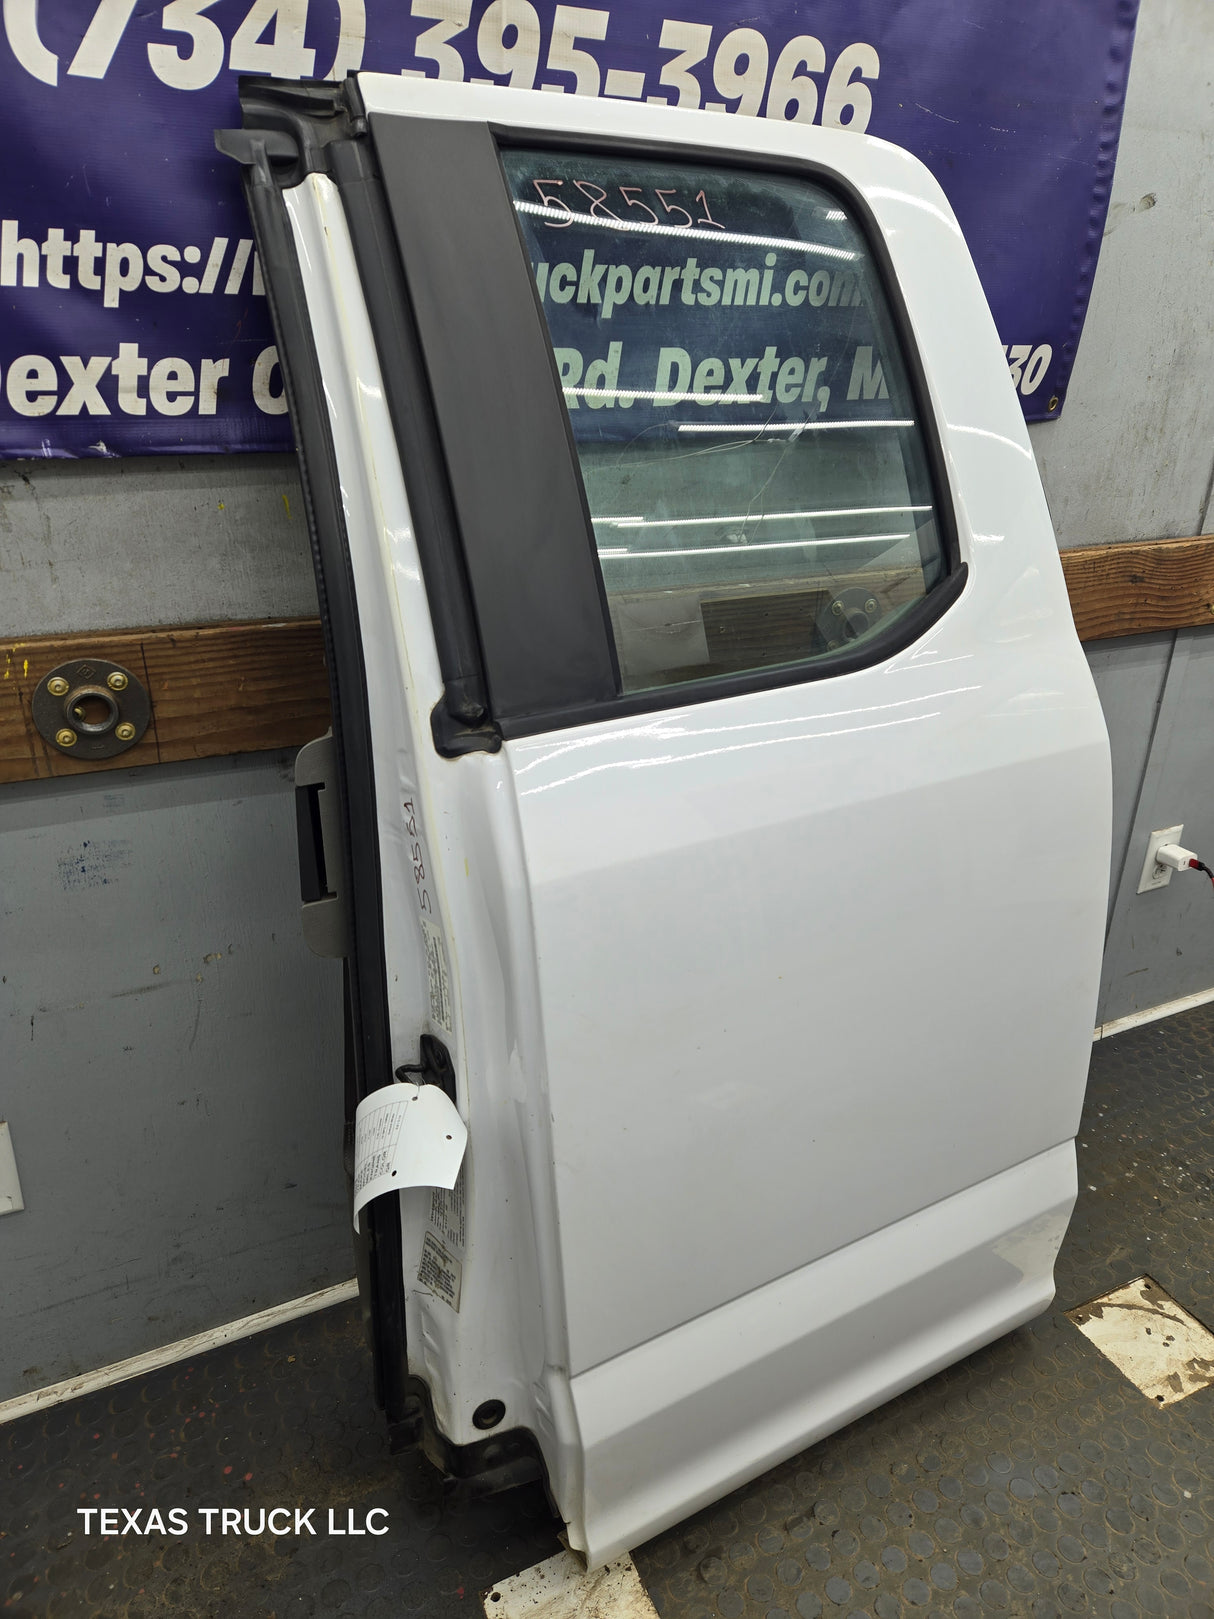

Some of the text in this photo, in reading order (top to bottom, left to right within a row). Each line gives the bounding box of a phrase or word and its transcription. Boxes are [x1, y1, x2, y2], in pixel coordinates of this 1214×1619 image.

[400, 0, 881, 135] 395-3966
[532, 179, 726, 231] 58551
[0, 342, 230, 416] exter
[553, 341, 634, 410] Rd.
[653, 346, 831, 413] Dexter,
[1002, 343, 1053, 395] 30
[403, 797, 432, 914] 58551
